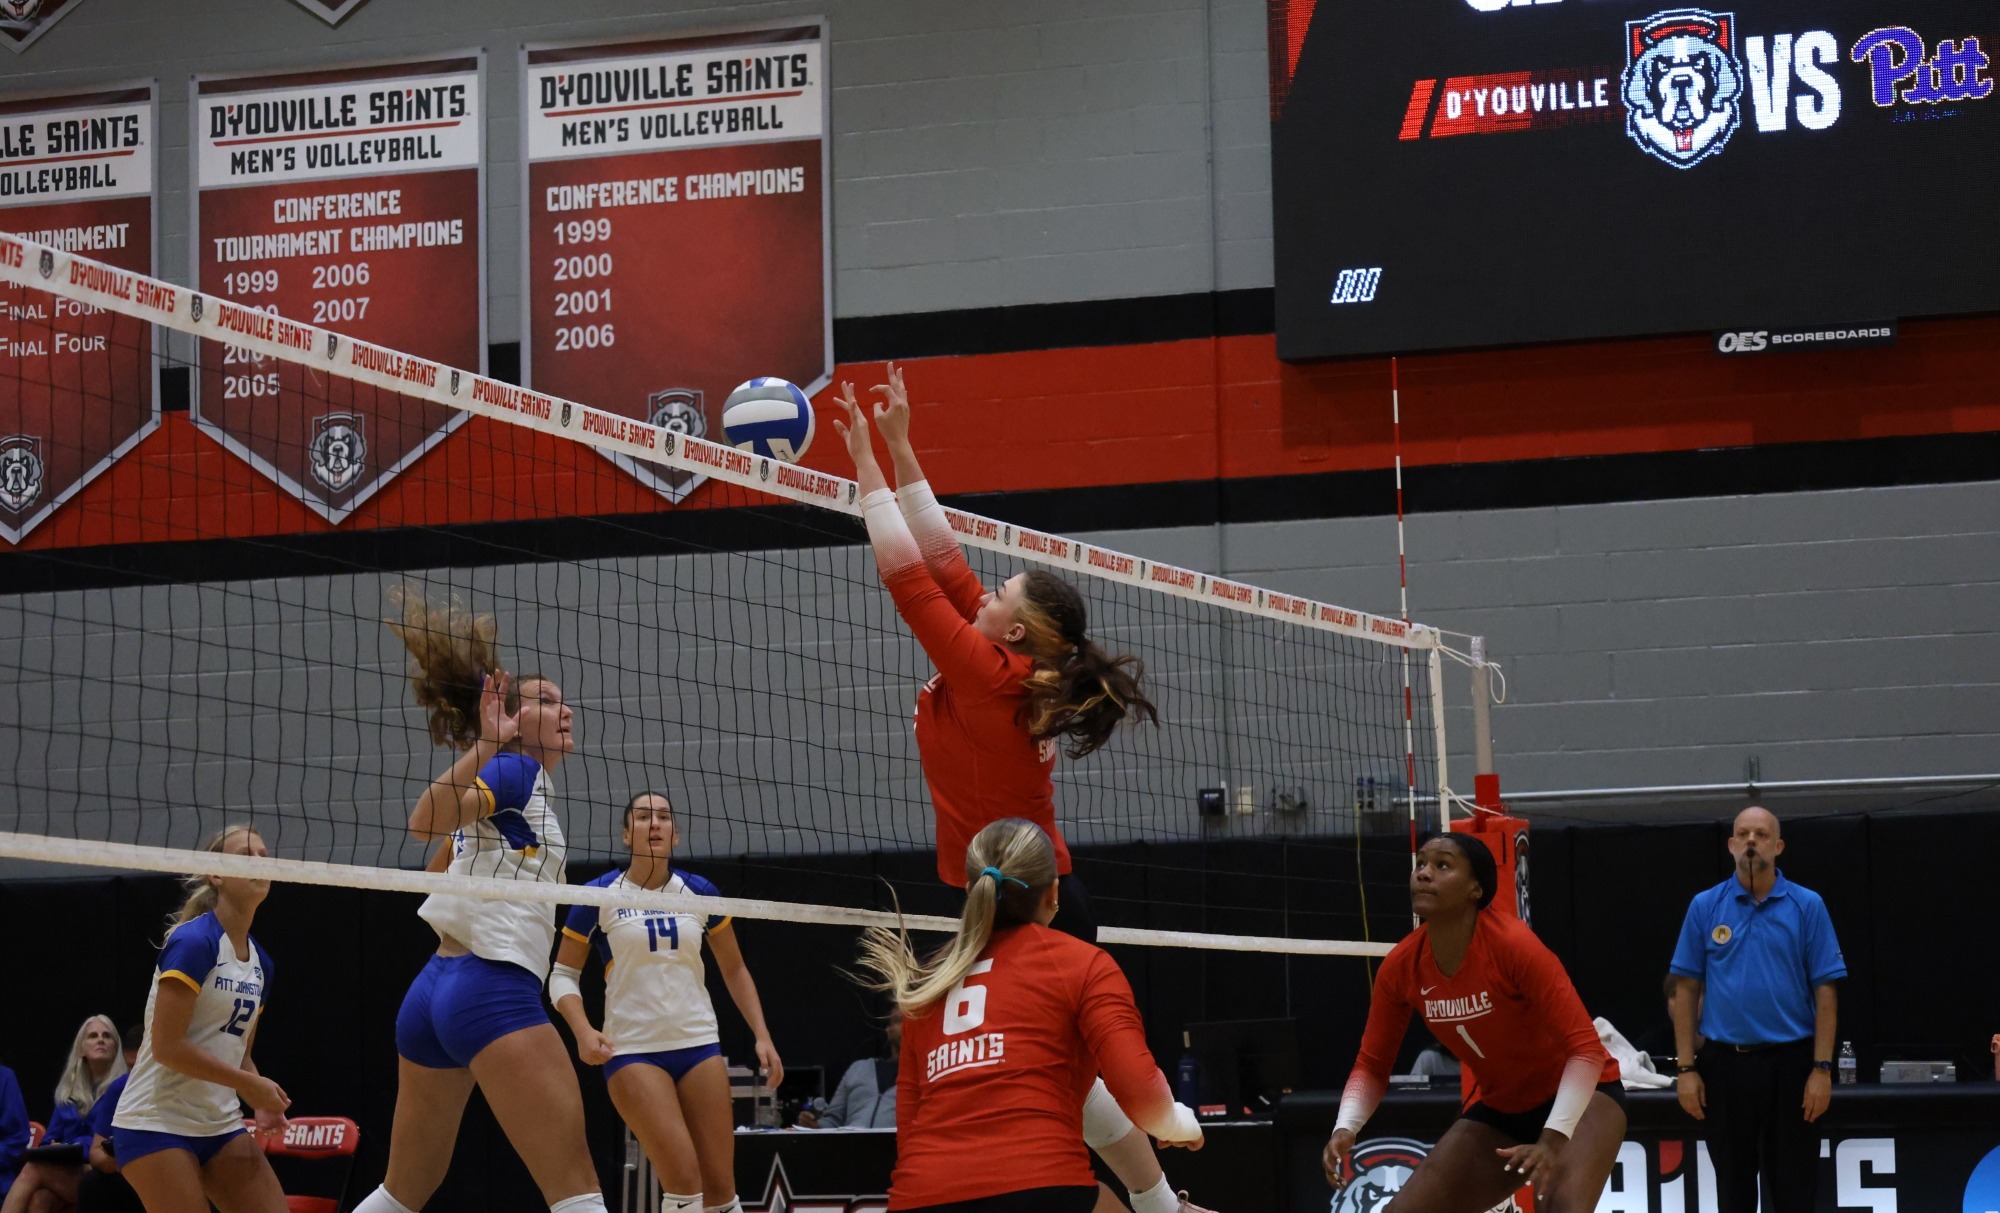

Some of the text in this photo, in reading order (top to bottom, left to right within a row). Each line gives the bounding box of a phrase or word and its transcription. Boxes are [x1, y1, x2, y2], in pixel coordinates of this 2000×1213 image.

[1746, 30, 1841, 132] VS
[1850, 26, 1993, 107] Pitt
[1446, 78, 1609, 119] D'YOUVILLE
[562, 105, 783, 147] MEN'S VOLLEYBALL
[231, 135, 442, 175] MEN'S VOLLEYBALL
[0, 163, 117, 196] OLLEYBALL
[546, 166, 805, 212] CONFERENCE CHAMPIONS
[274, 189, 402, 224] CONFERENCE
[15, 223, 130, 252] RNAMENT
[213, 219, 463, 262] TOURNAMENT CHAMPIONS
[553, 218, 612, 245] 1999
[223, 262, 370, 295] 1999 2006
[553, 253, 613, 281] 2000
[312, 297, 370, 324] 2007
[554, 288, 613, 317] 2001
[55, 333, 105, 353] FOUR
[224, 343, 276, 364] 200
[554, 324, 615, 351] 2006
[1718, 328, 1891, 352] OES SCOREBOARDS
[223, 373, 280, 399] 2005
[645, 917, 678, 952] 14
[214, 976, 234, 992] PITT
[943, 958, 994, 1035] 6
[219, 998, 256, 1037] 12
[1456, 1025, 1486, 1059] 1
